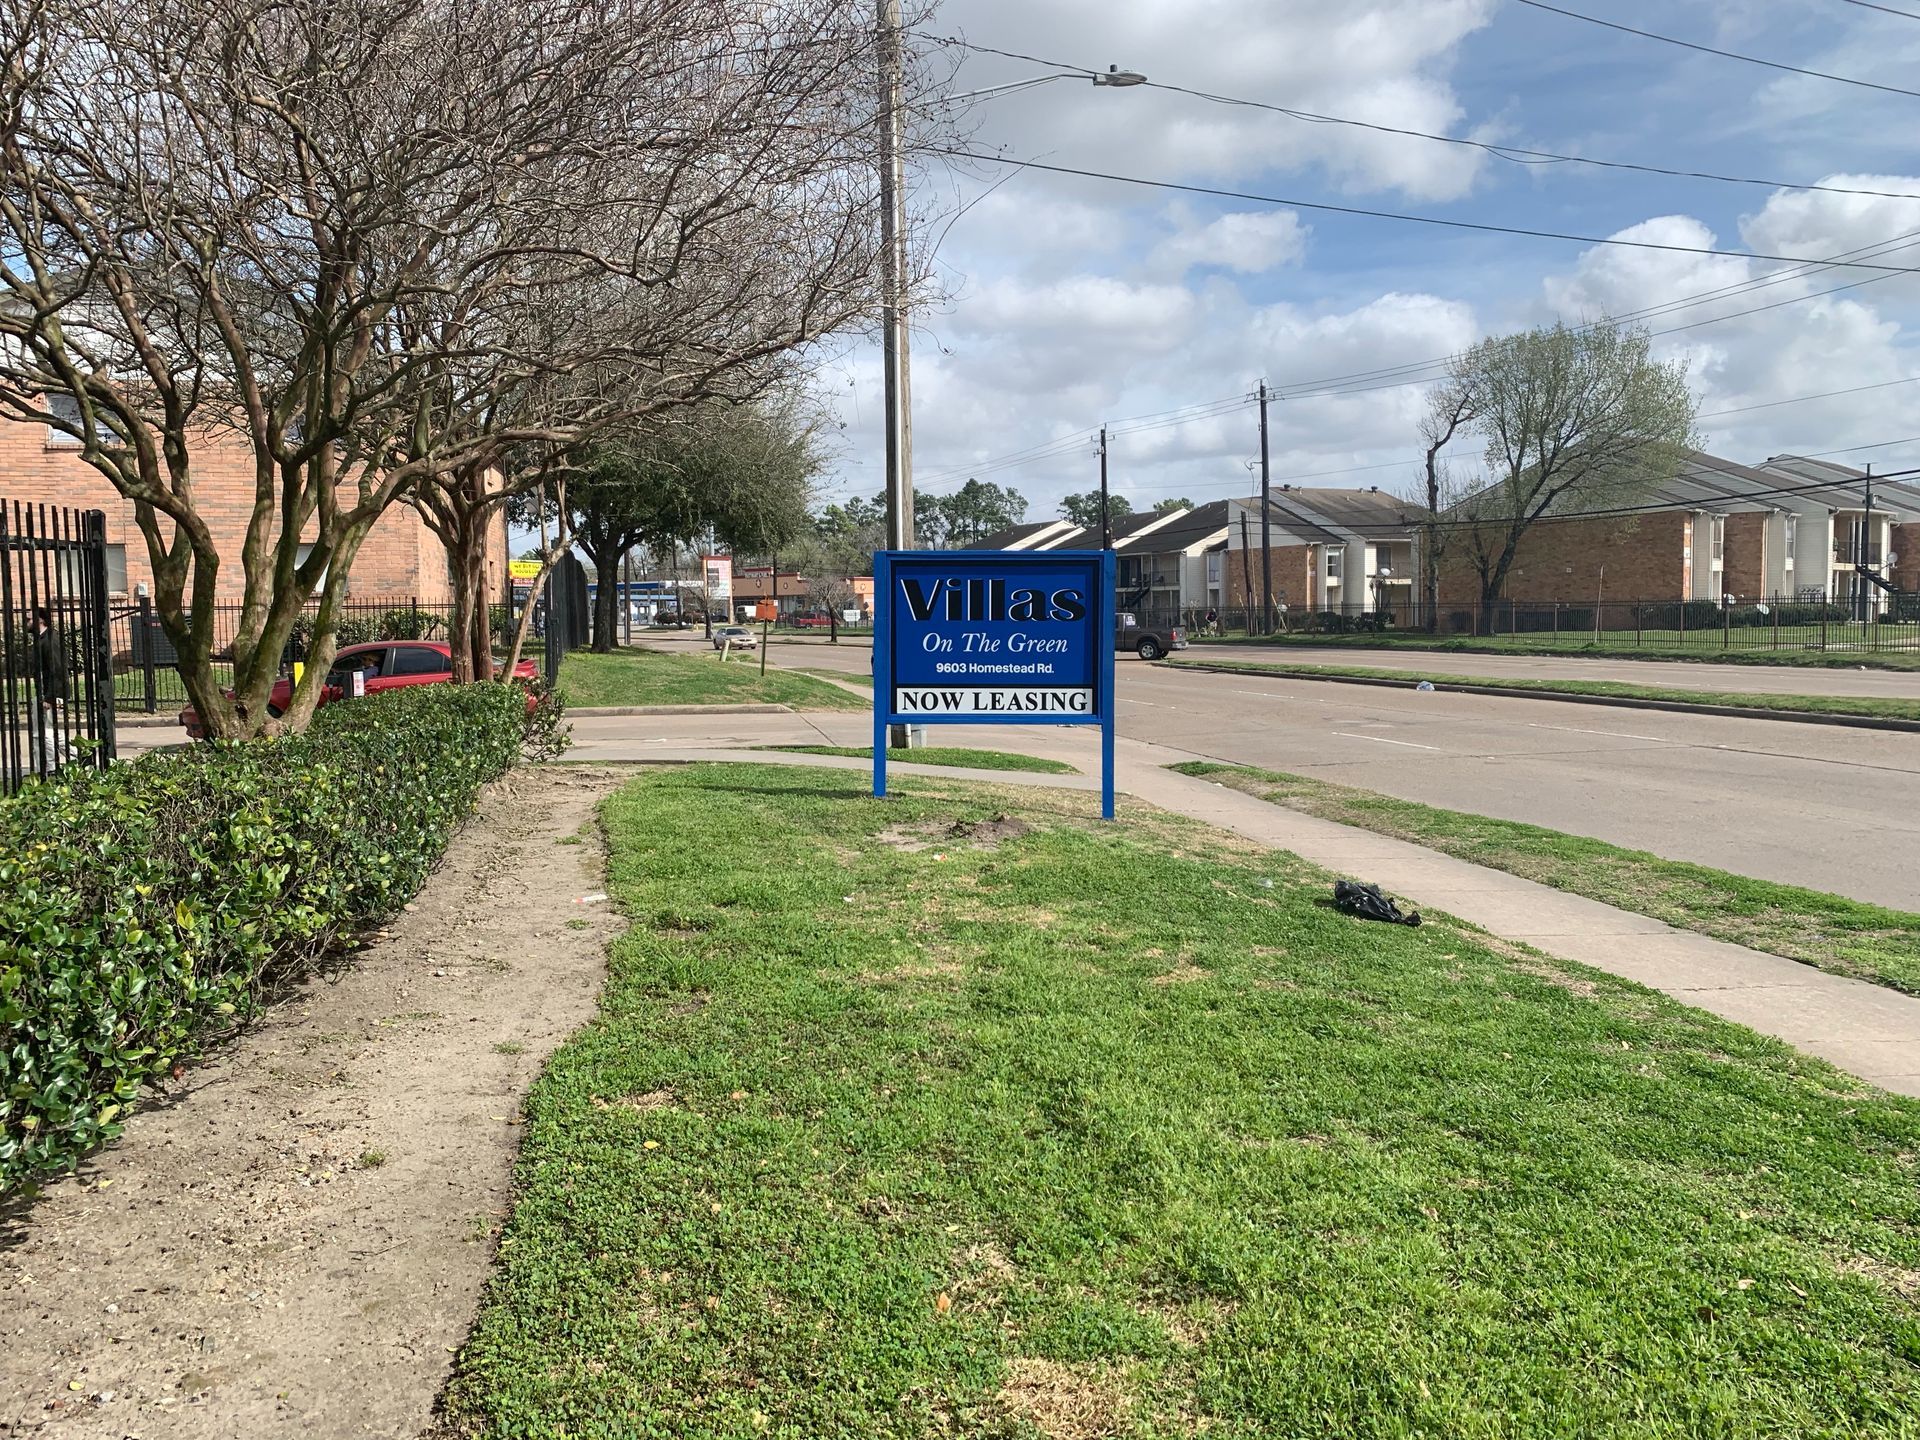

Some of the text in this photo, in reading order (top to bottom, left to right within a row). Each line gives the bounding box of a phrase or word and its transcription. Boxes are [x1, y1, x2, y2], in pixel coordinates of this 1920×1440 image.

[900, 578, 1086, 622] Villas
[922, 632, 1068, 653] On The Green
[936, 662, 1055, 674] 9603 Homestead Rd.
[902, 691, 1088, 711] NOW LEASING
